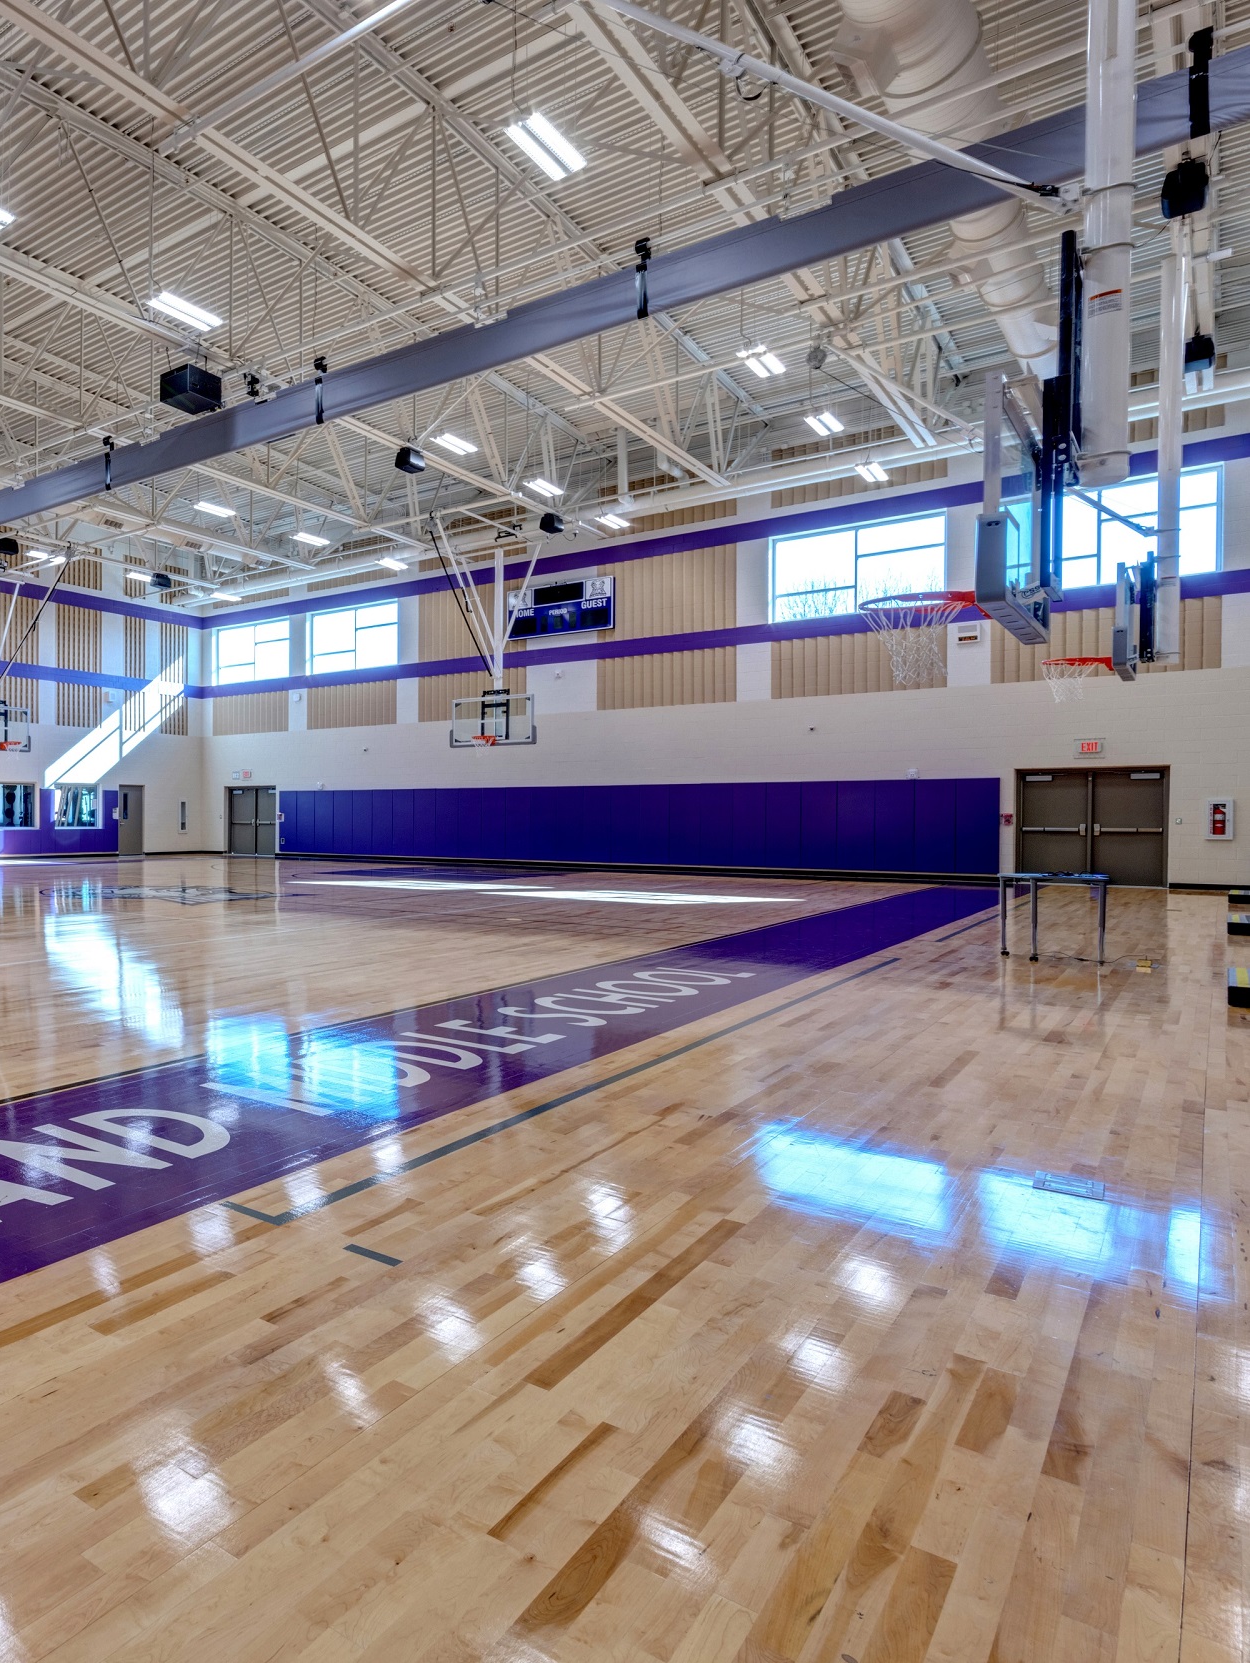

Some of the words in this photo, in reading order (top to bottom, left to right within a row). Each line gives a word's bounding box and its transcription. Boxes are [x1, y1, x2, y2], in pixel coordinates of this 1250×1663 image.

[581, 599, 607, 609] GUEST
[1081, 741, 1098, 752] EXIT
[497, 967, 757, 1027] SCHOOL
